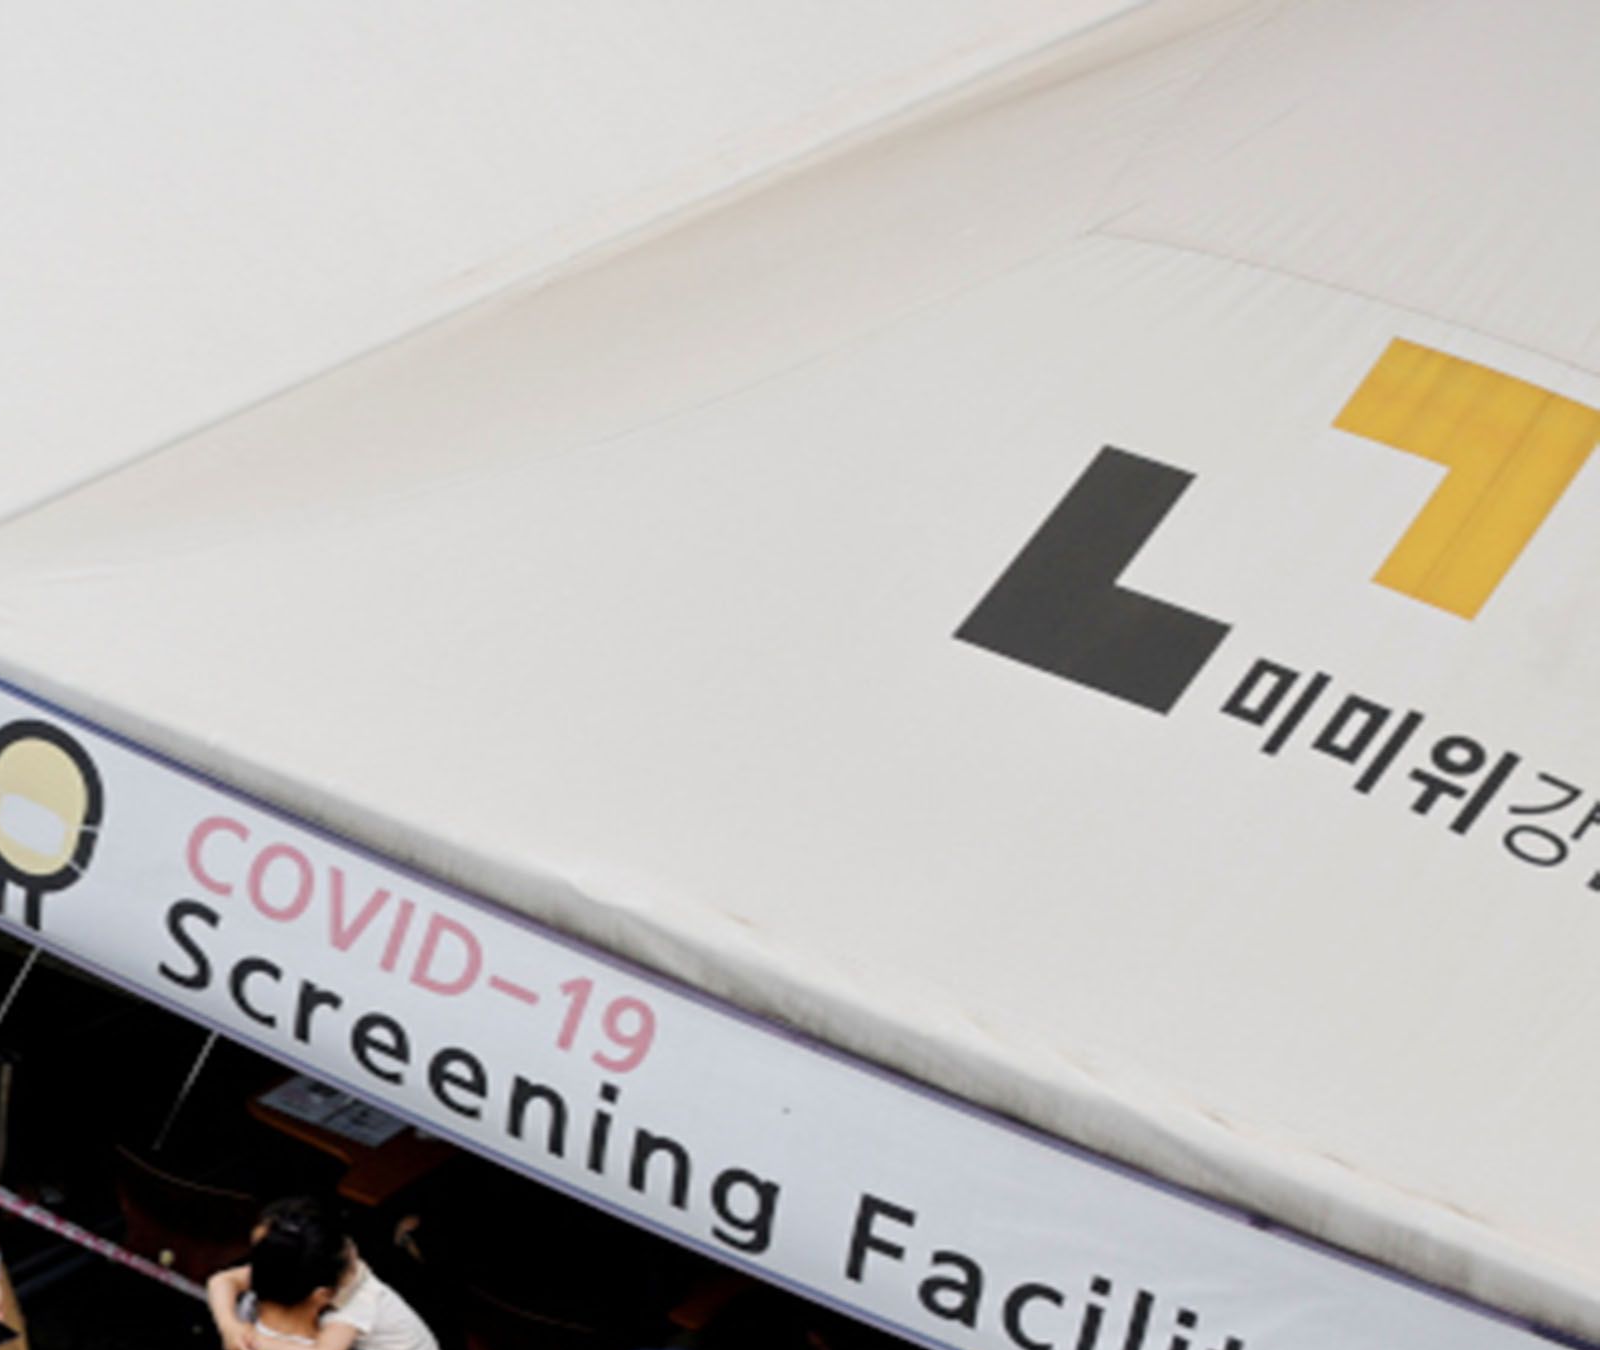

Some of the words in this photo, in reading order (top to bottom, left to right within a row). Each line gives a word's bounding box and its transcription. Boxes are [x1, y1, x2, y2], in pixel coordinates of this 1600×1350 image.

[1220, 656, 1600, 893] 미미위강
[186, 815, 656, 1074] COVID-19
[158, 897, 781, 1256] Screening
